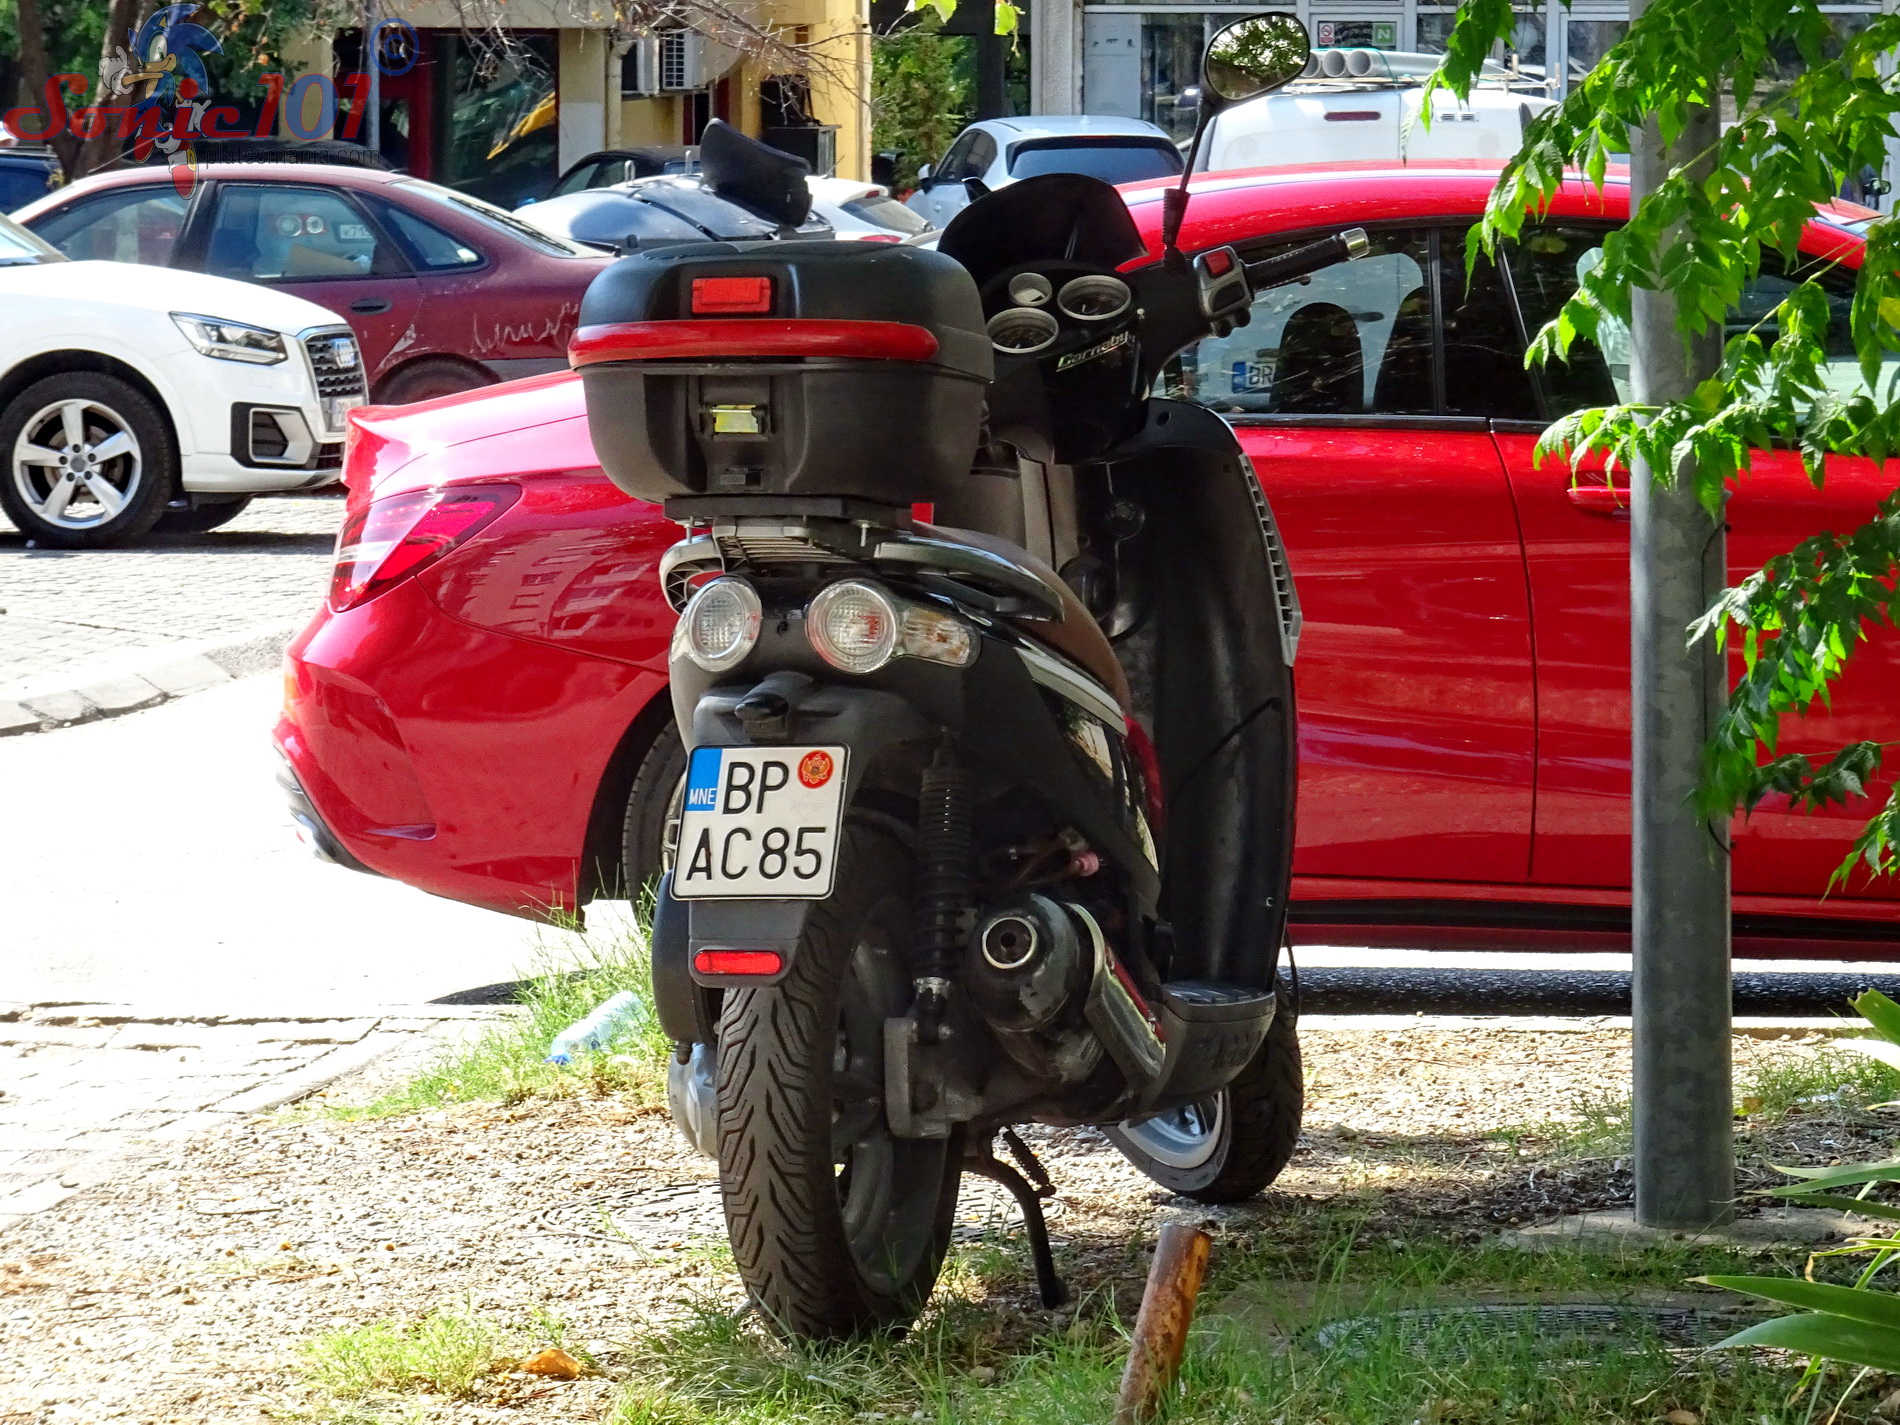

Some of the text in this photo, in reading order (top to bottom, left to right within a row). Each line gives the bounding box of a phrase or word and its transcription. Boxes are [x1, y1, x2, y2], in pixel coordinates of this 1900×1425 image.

[1056, 331, 1130, 370] Carnaby
[688, 787, 717, 806] MNE
[722, 761, 789, 814] BP
[685, 827, 826, 881] AC85
